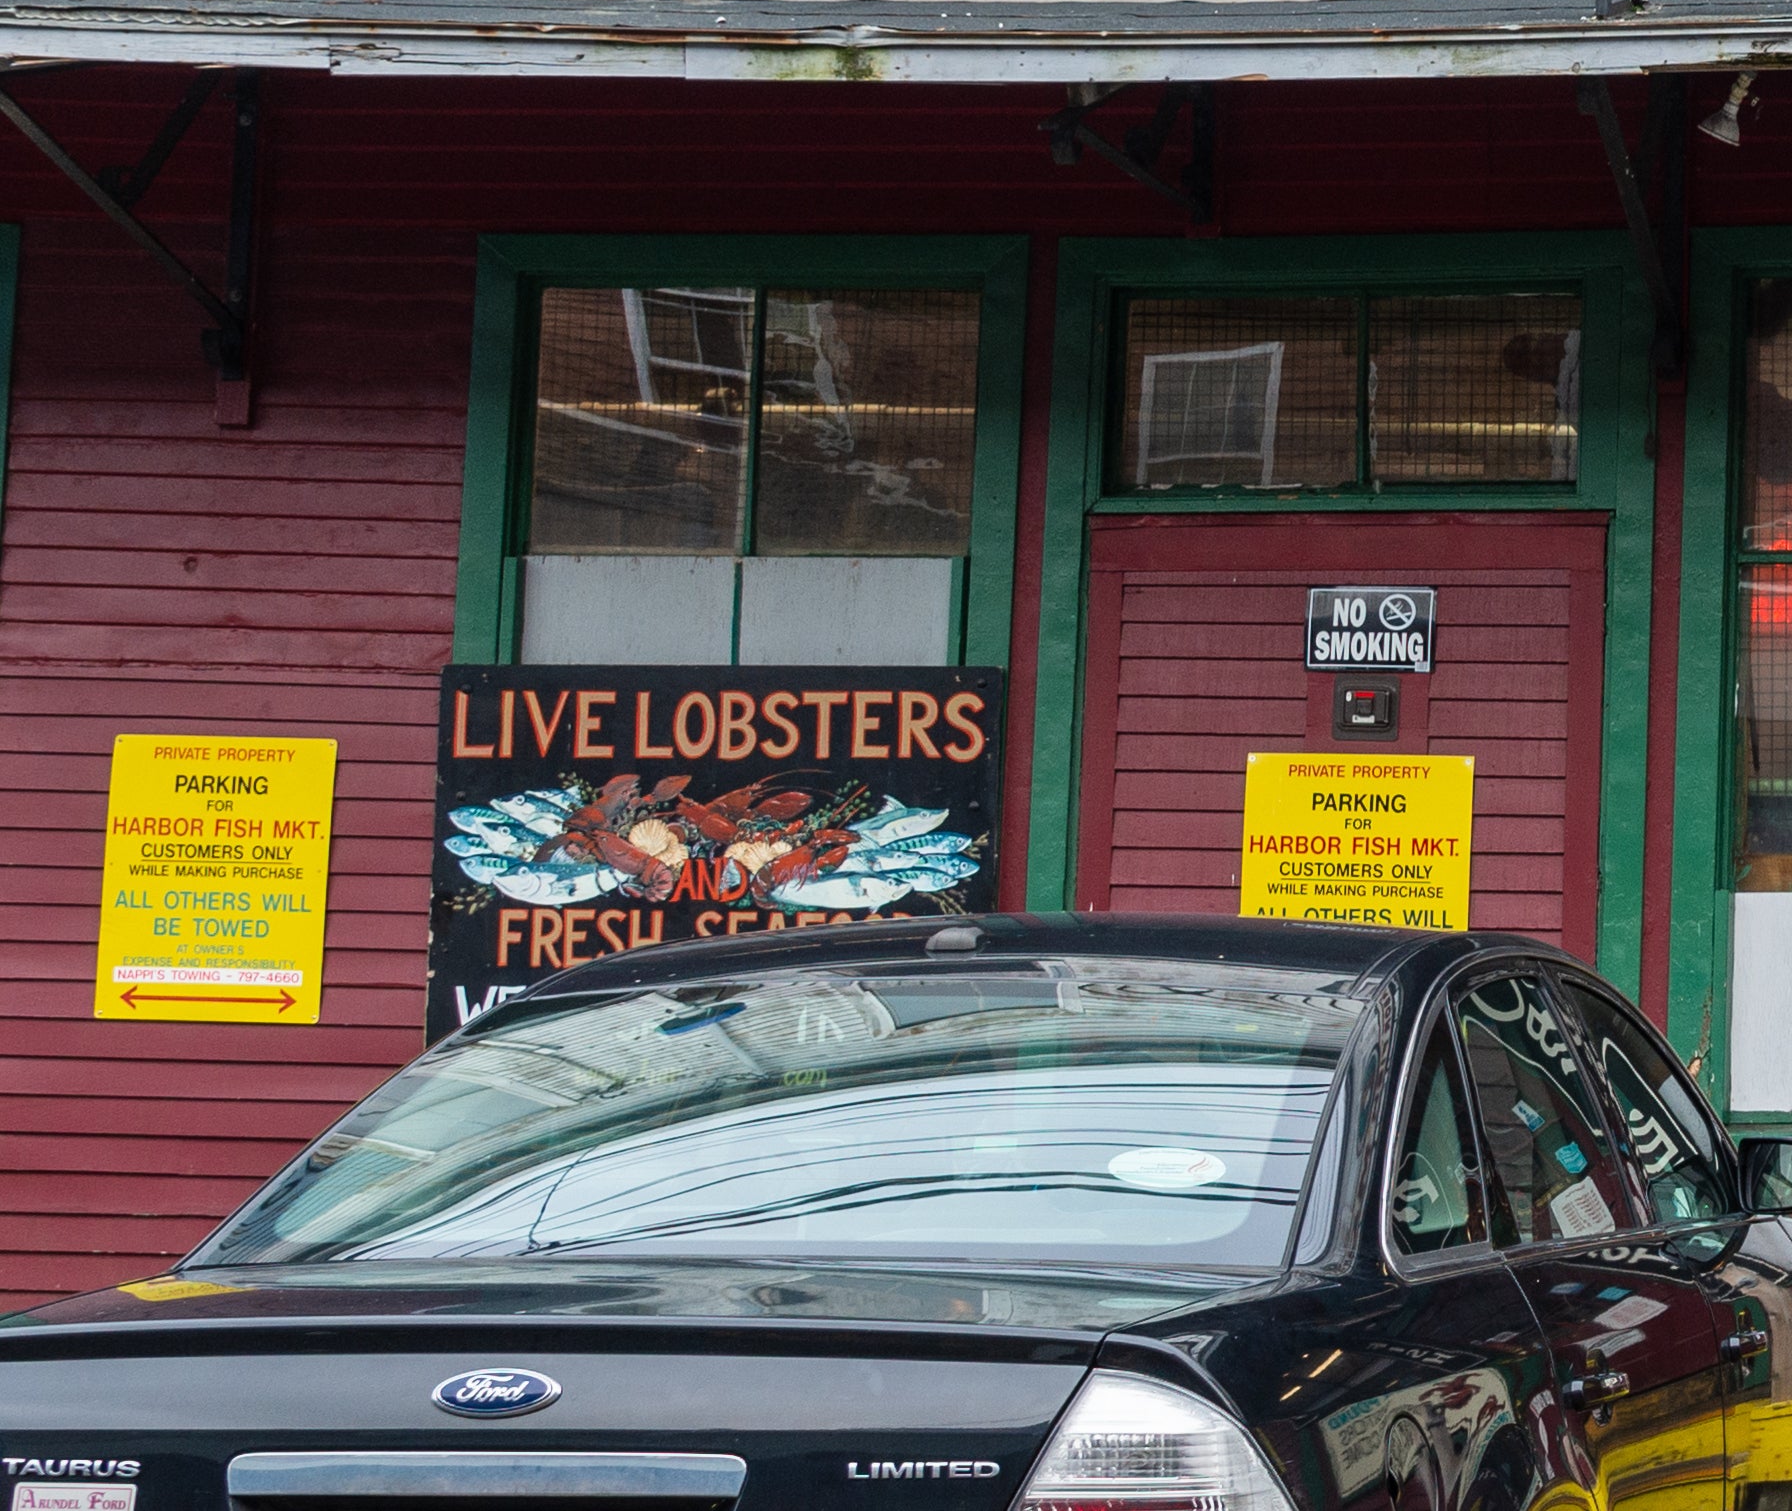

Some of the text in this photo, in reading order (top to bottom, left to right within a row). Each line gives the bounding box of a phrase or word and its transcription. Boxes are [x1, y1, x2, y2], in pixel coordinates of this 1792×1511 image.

[1332, 598, 1367, 628] NO
[1314, 631, 1424, 662] SMOKING
[453, 690, 987, 762] LIVE LOBSTERS
[154, 746, 295, 762] PRIVATE PROPERTY
[1288, 764, 1431, 779] PRIVATE PROPERTY
[174, 774, 269, 795] PARKING
[206, 800, 234, 812] FOR
[1312, 792, 1407, 813] PARKING
[113, 817, 325, 840] HARBOR FISH MKT.
[1344, 818, 1372, 830] FOR
[141, 843, 293, 860] CUSTOMERS ONLY
[1249, 835, 1459, 857] HARBOR FISH MKT.
[129, 864, 304, 880] WHILE MAKING PURCHASE
[672, 857, 750, 903] AND
[1279, 862, 1433, 879] CUSTOMERS ONLY
[1267, 884, 1444, 898] WHILE MAKING PURCHASE
[114, 890, 311, 913] ALL OTHERS WILL
[153, 918, 270, 938] BE TOWED
[1402, 909, 1454, 929] WILL
[497, 908, 664, 969] FRESH
[117, 969, 300, 984] NAPPI'S TOWING 797-4660
[456, 1374, 525, 1406] Ford
[2, 1458, 141, 1477] TAURUS
[847, 1461, 1001, 1479] LIMITED
